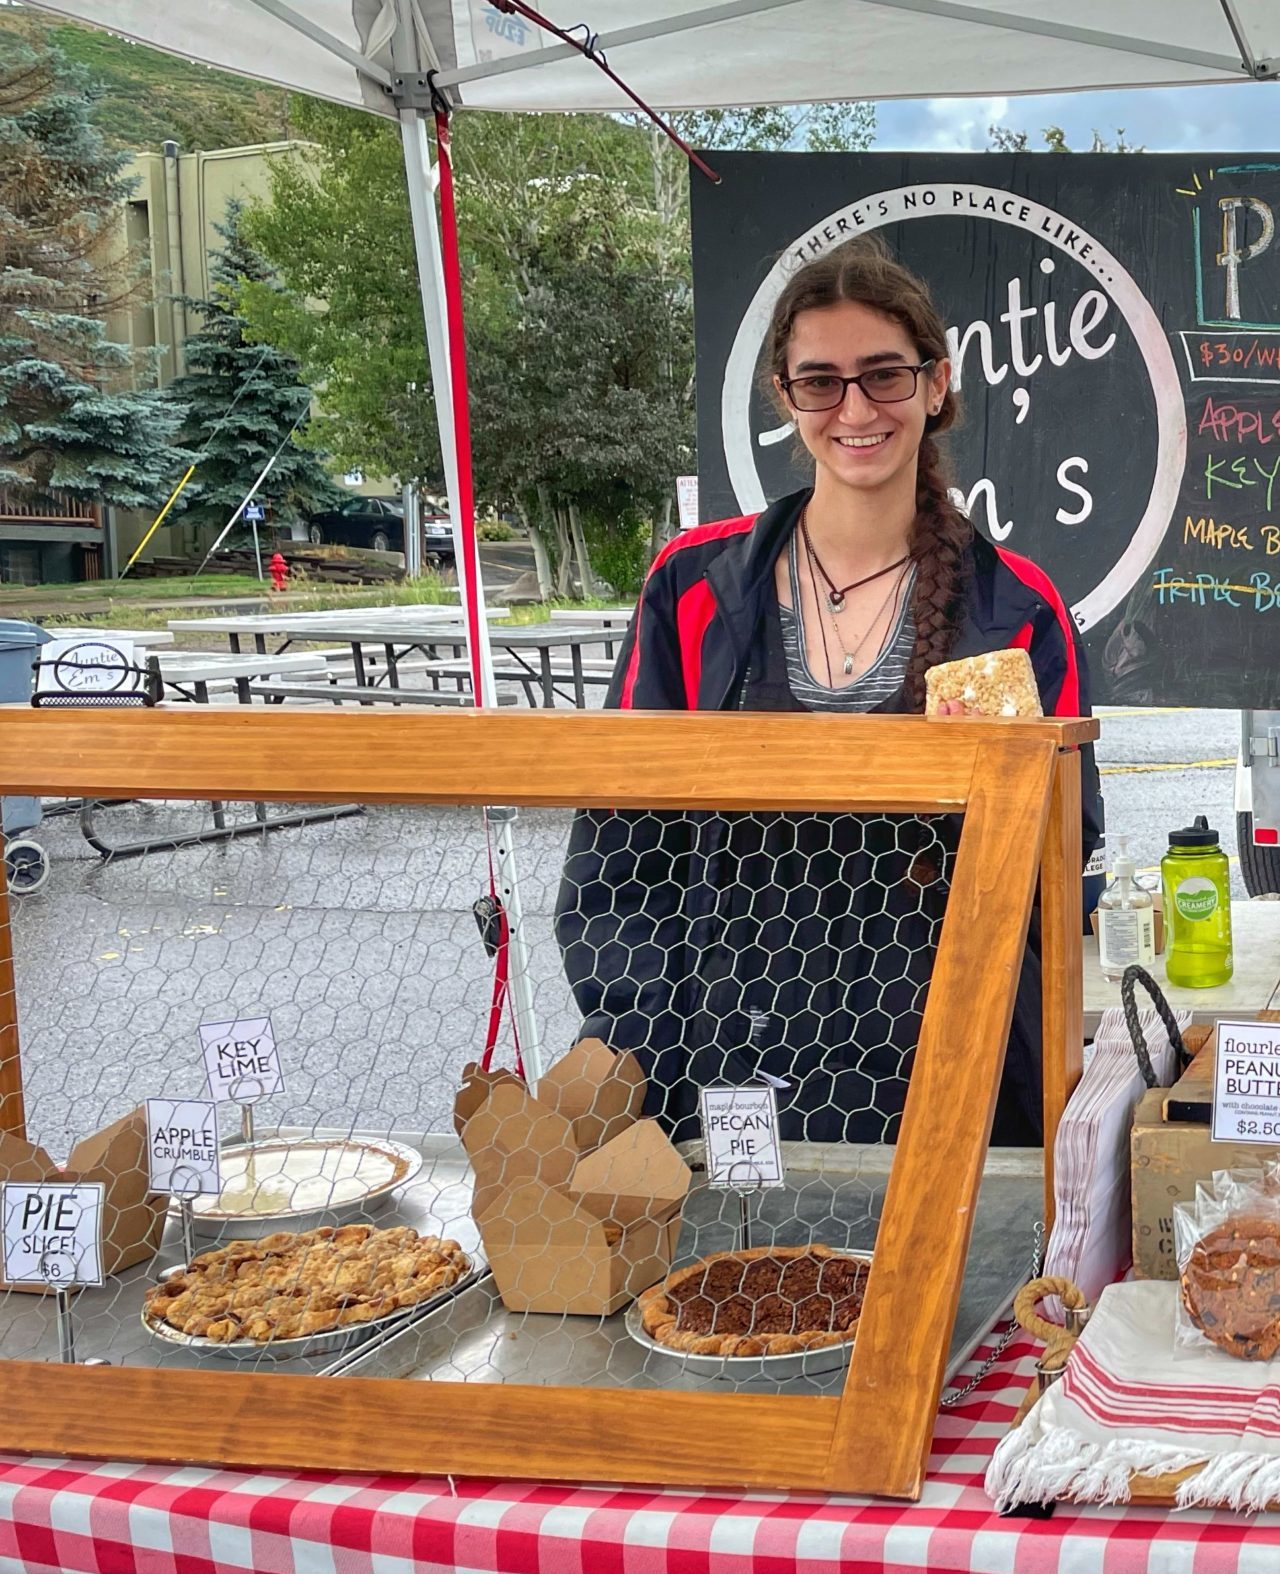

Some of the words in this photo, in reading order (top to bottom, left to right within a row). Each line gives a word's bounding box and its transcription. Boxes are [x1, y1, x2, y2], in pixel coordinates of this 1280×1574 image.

[795, 200, 888, 263] THERE'S
[904, 191, 936, 209] NO
[953, 191, 1030, 222] PLACE
[946, 258, 1117, 392] ntie
[1184, 516, 1254, 550] MAPLE
[217, 1039, 261, 1060] KEY
[217, 1056, 270, 1078] LIME
[711, 1115, 769, 1131] PECAN
[154, 1127, 213, 1147] APPLE
[730, 1139, 756, 1156] PIE
[154, 1147, 215, 1161] CRUMBLE
[22, 1193, 78, 1230] PIE
[22, 1235, 76, 1256] SLICE!
